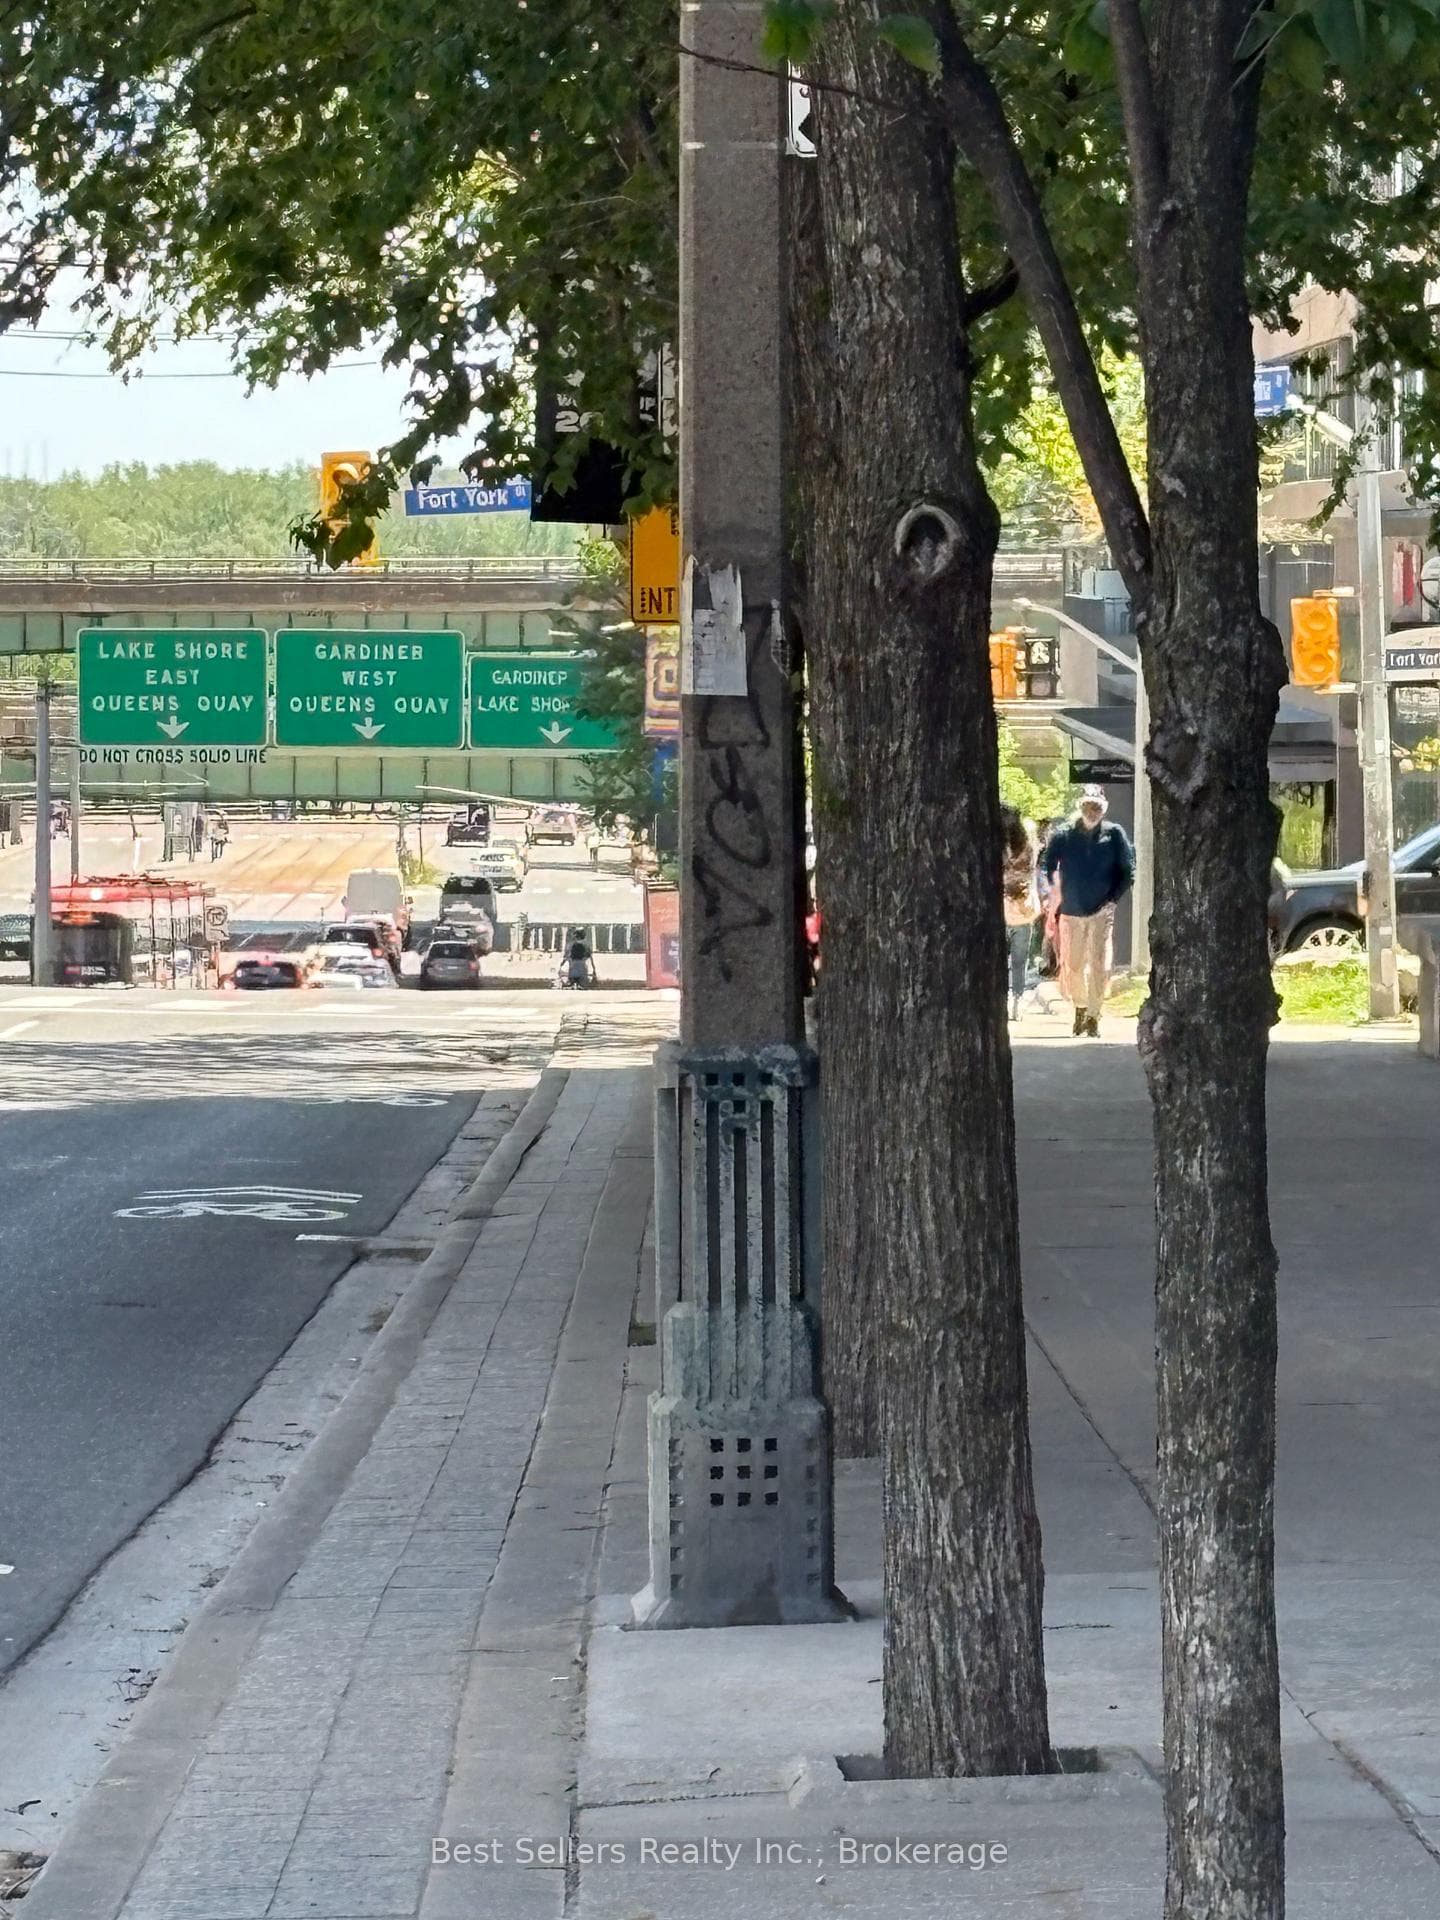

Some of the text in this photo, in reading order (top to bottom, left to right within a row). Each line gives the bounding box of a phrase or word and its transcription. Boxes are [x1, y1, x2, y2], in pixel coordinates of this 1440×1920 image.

[418, 489, 457, 509] Fort
[464, 488, 508, 507] York
[98, 641, 248, 660] LAKE SHORE
[314, 643, 424, 660] GARDINER
[145, 669, 200, 685] EAST
[341, 670, 398, 686] WEST
[91, 695, 254, 712] QUEENS QUAY
[289, 695, 449, 714] QUEENS QUAY
[478, 695, 519, 712] LAKE
[79, 749, 267, 764] DO NOT CROSS SOLID LINE
